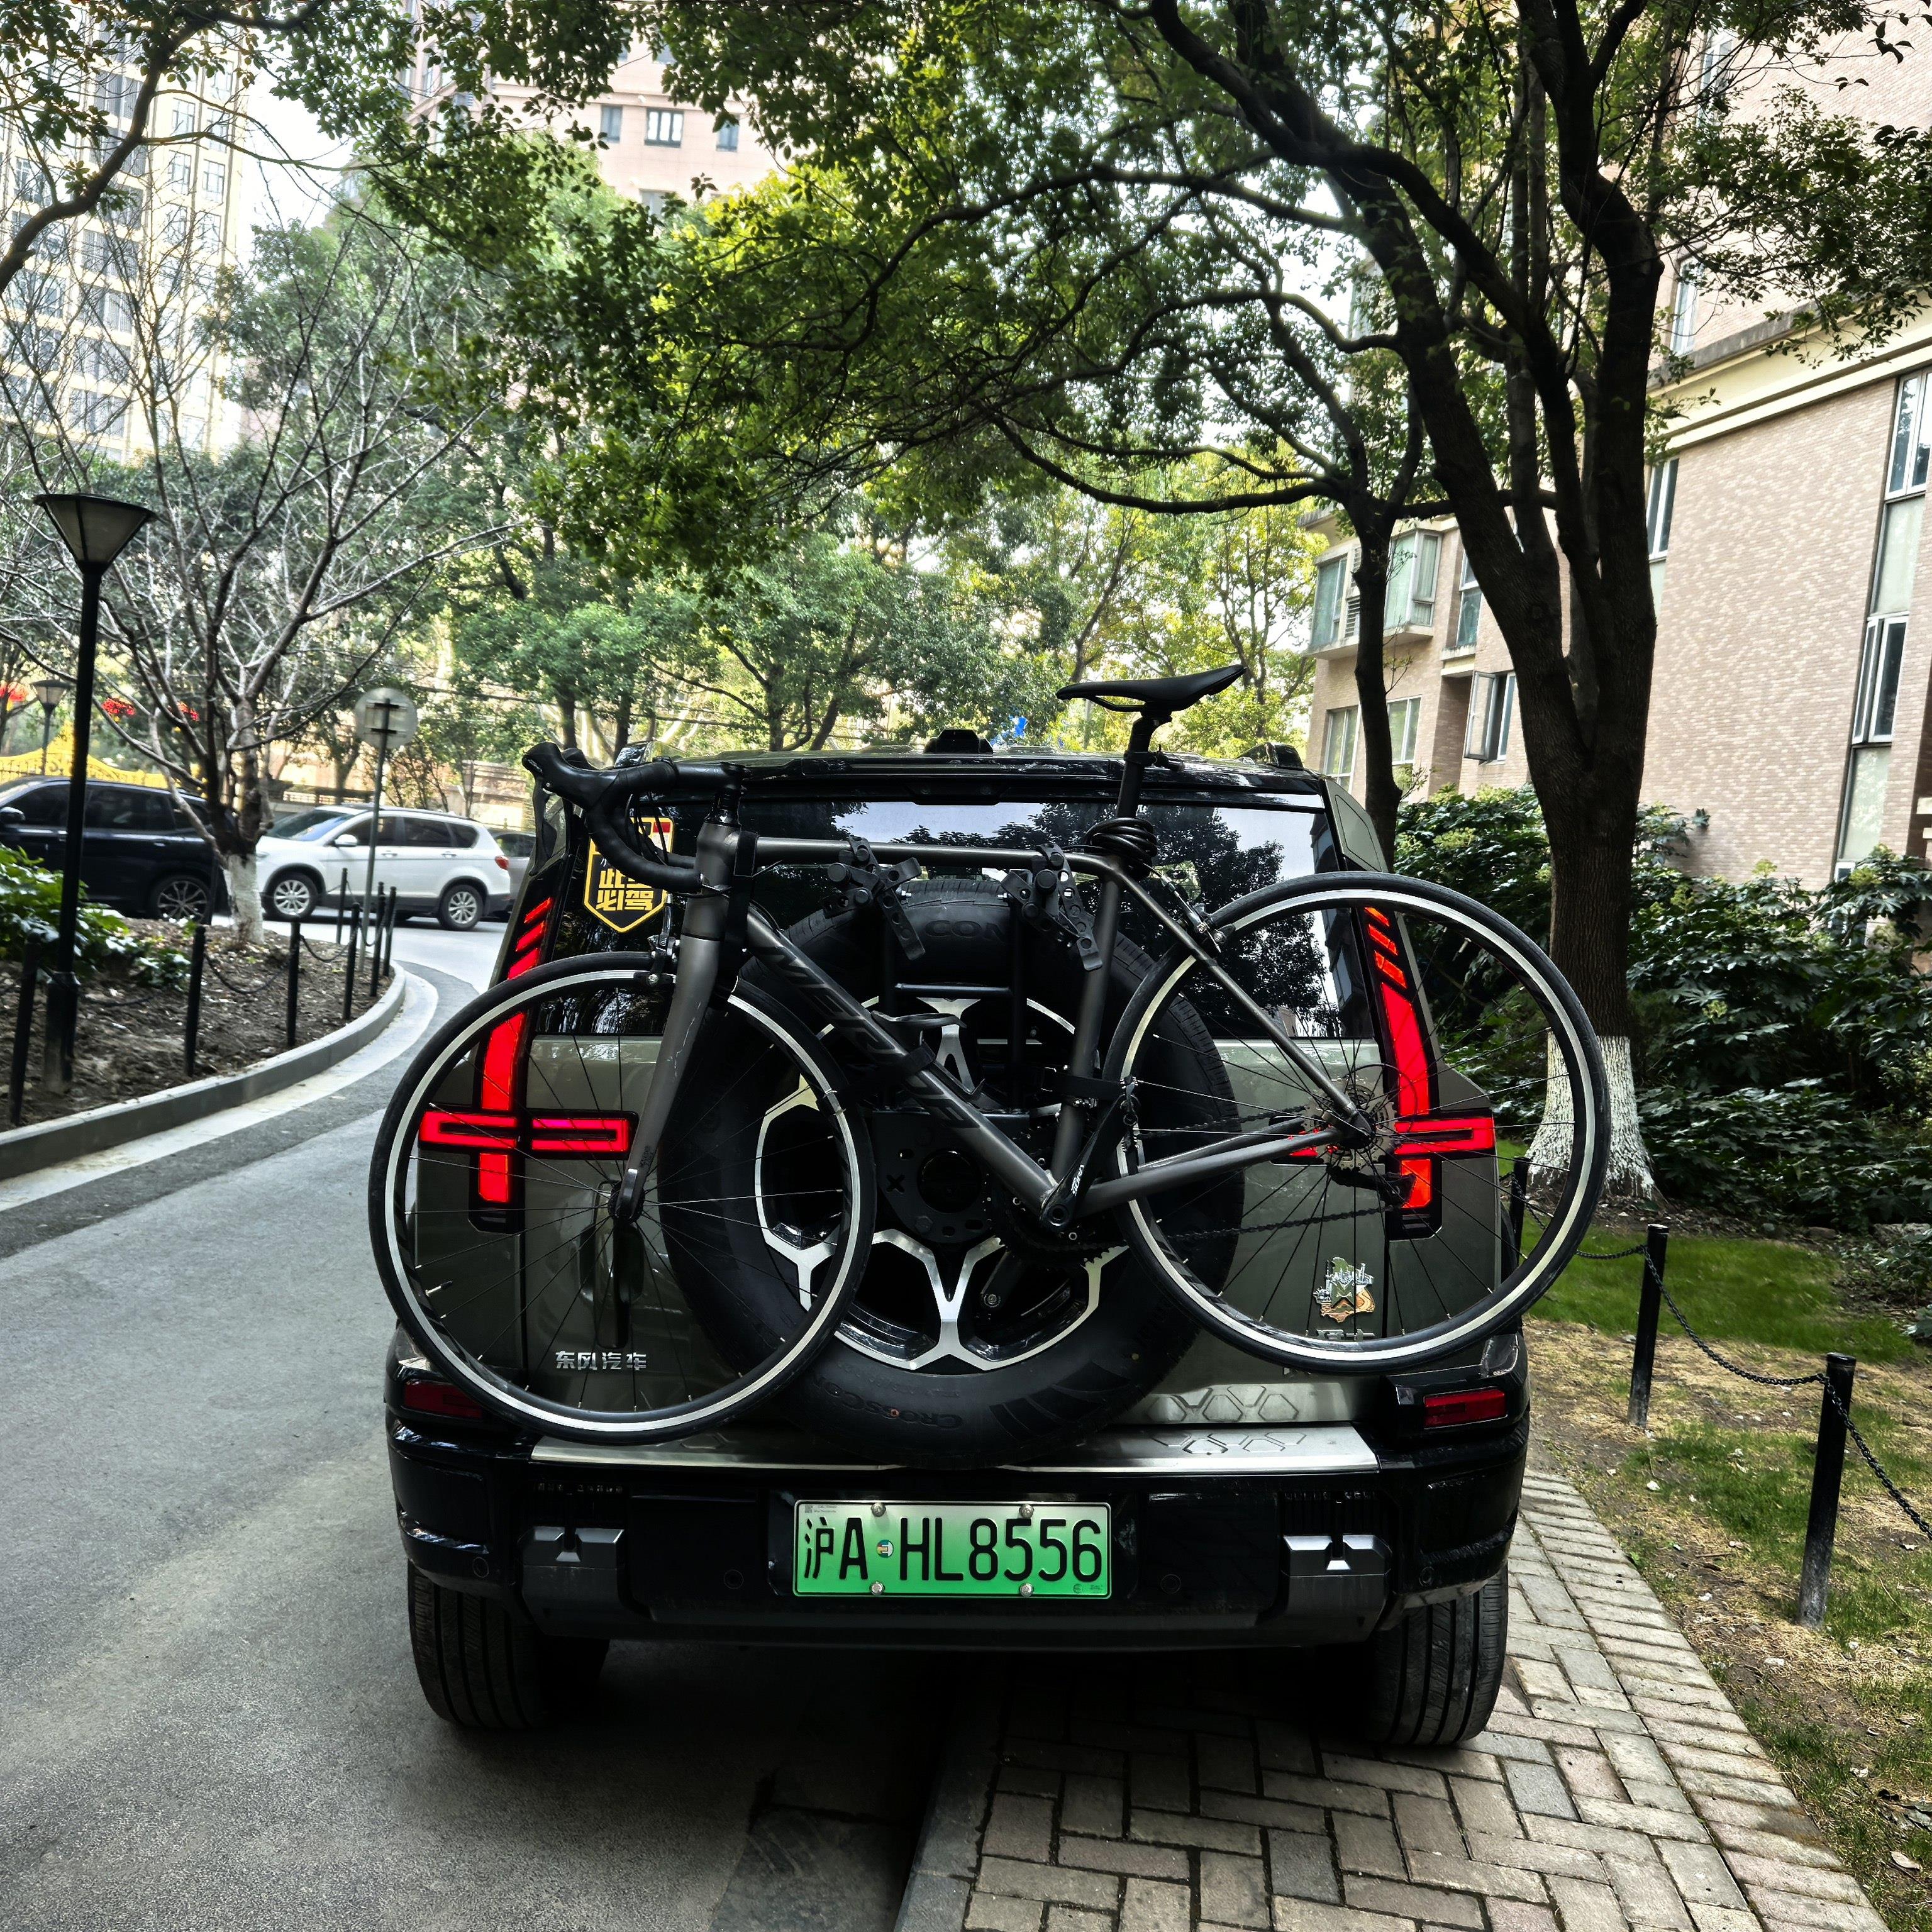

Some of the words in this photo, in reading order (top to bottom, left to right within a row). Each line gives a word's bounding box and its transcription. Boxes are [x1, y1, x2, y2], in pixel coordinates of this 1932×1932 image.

[599, 868, 652, 888] 此
[596, 890, 653, 911] 必驾
[555, 1351, 647, 1370] 东风汽车
[899, 1517, 1102, 1582] HL8556
